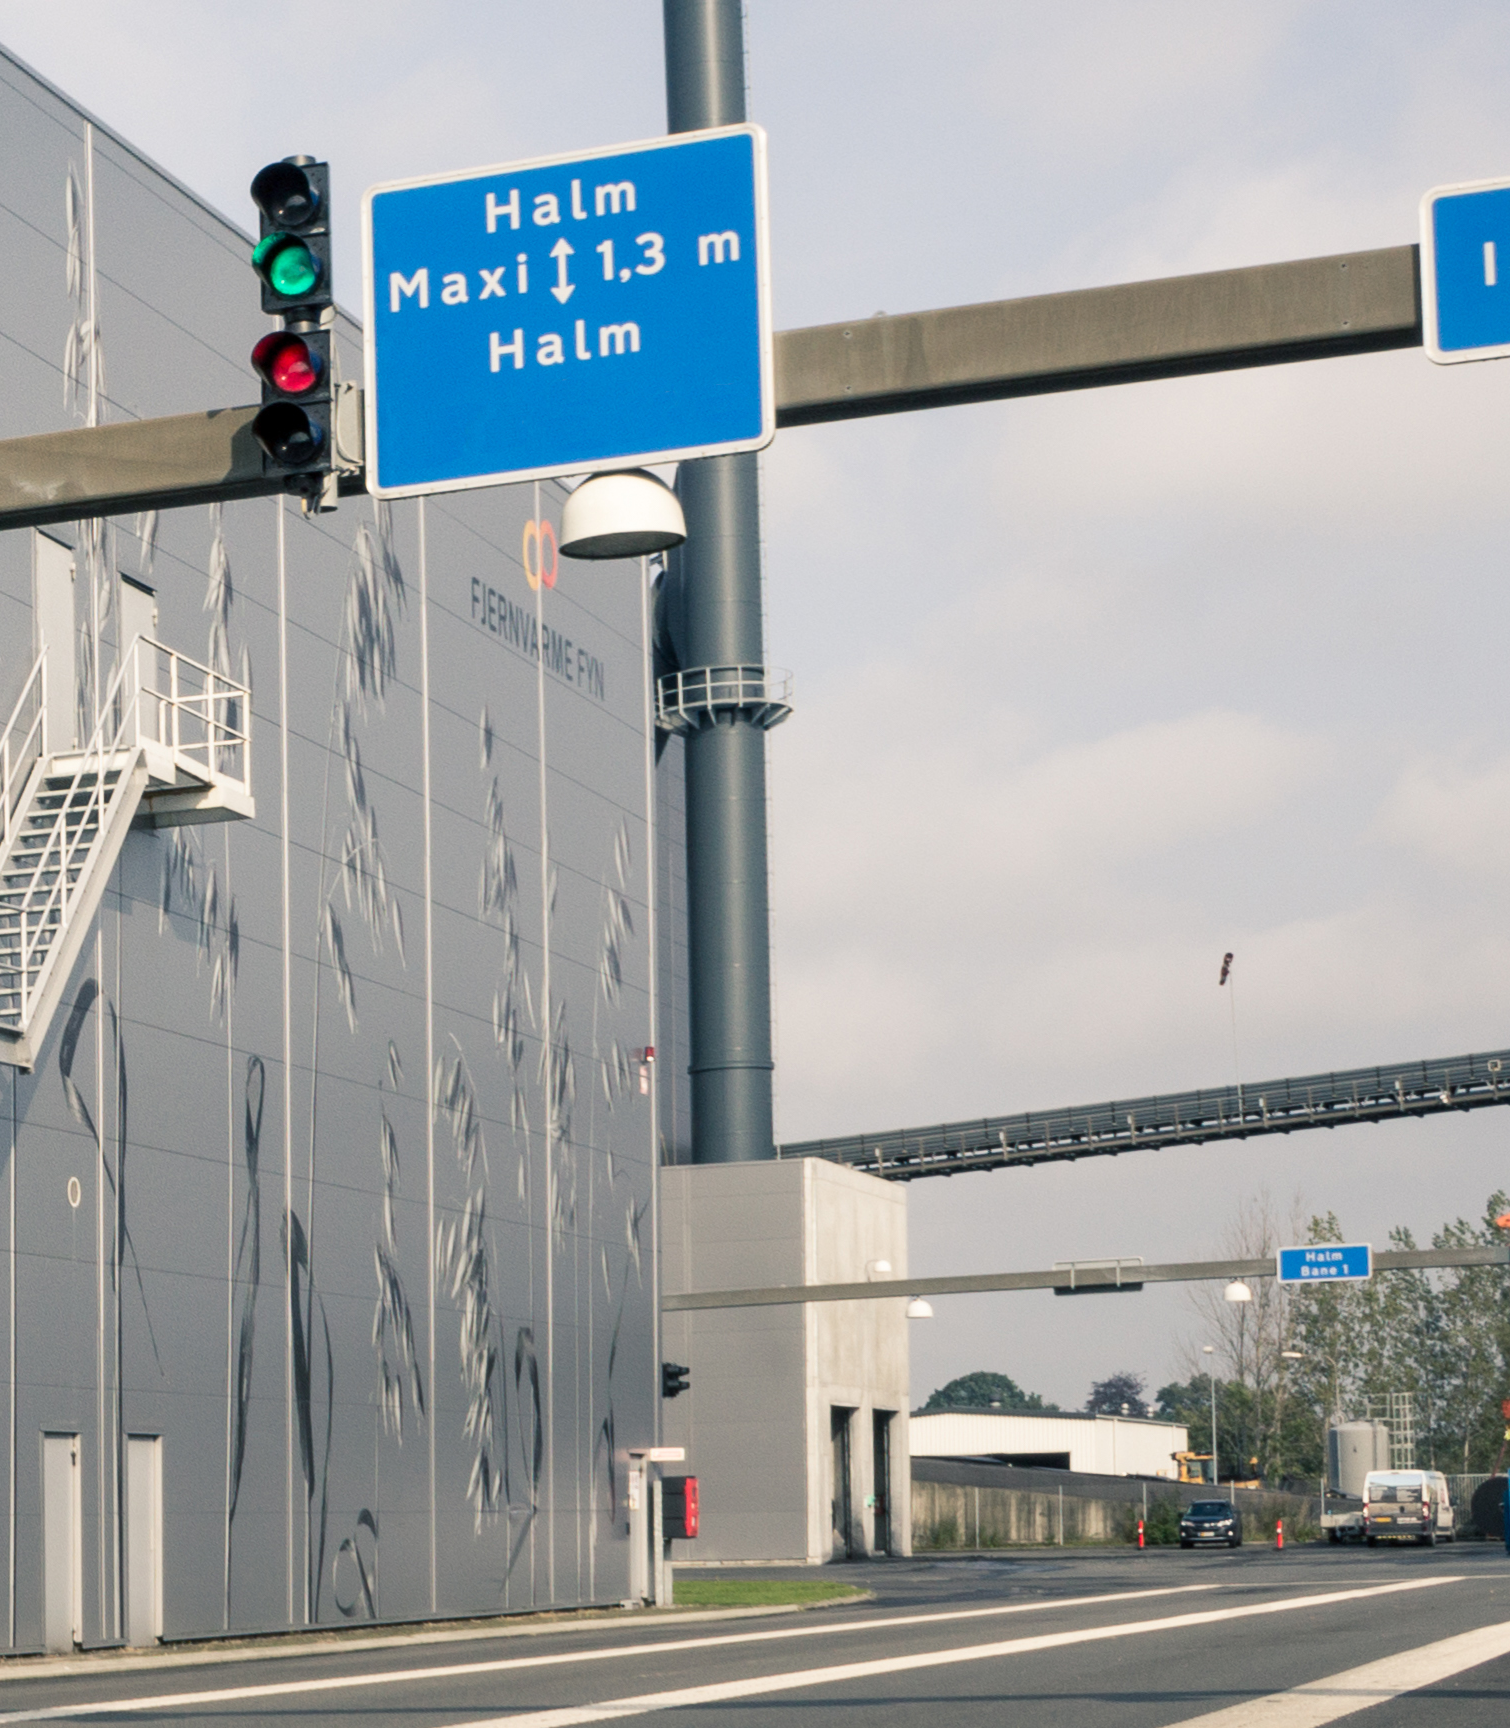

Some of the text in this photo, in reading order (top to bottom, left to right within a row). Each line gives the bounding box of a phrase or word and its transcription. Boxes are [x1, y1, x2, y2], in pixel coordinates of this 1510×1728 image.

[485, 178, 636, 234] Halm
[389, 230, 740, 313] Maxi 1,3 m
[489, 319, 641, 373] Halm
[471, 576, 605, 700] FJERNVARME FYN
[1300, 1264, 1348, 1276] Bane 1
[1305, 1251, 1343, 1262] Halm
